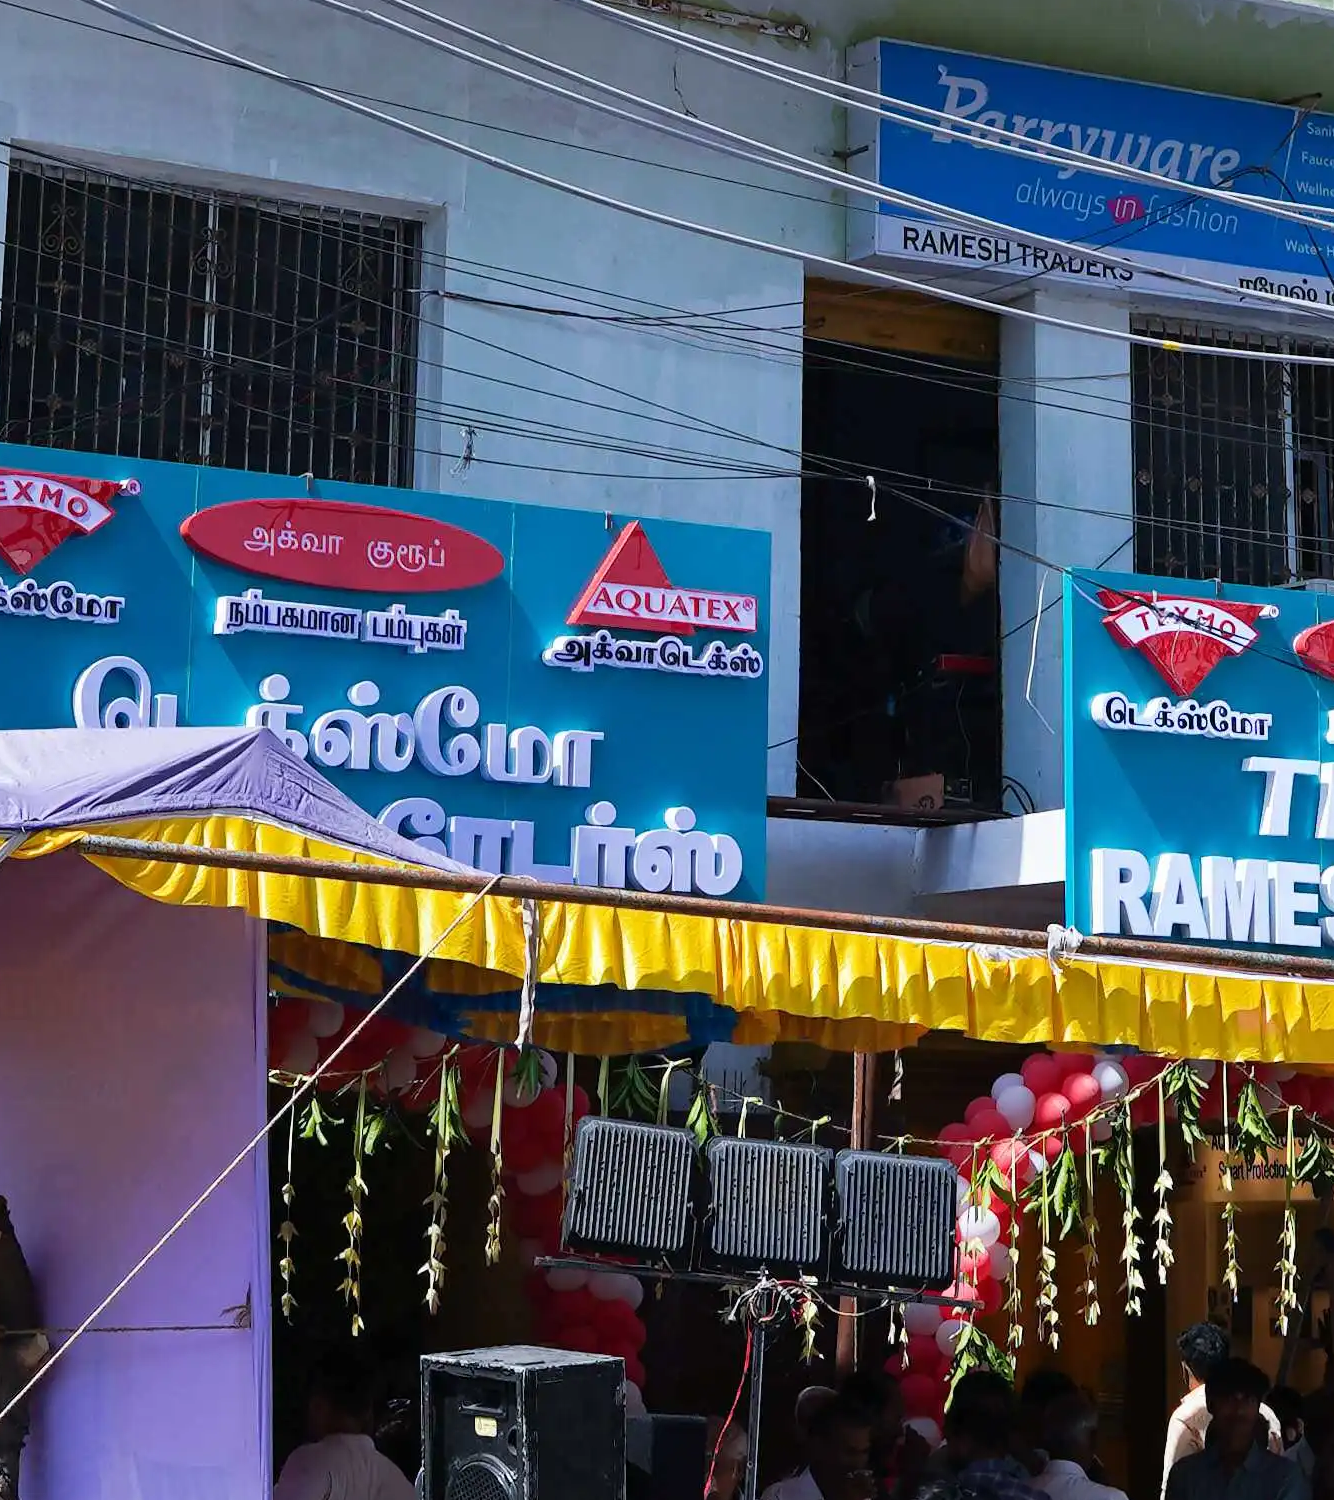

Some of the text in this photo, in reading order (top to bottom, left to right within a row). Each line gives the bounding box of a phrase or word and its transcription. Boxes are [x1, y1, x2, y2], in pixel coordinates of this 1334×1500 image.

[932, 65, 1240, 188] Parryware
[1017, 178, 1239, 234] always in fashion
[902, 227, 1010, 262] RAMESH
[243, 520, 445, 572] அக்வா குரூப்
[227, 594, 463, 647] நம்பகமான பம்புகள்
[594, 587, 740, 622] AQUATEX
[555, 635, 760, 673] அக்வாடெக்ஸ்
[1106, 697, 1269, 736] டெக்ஸ்மோ
